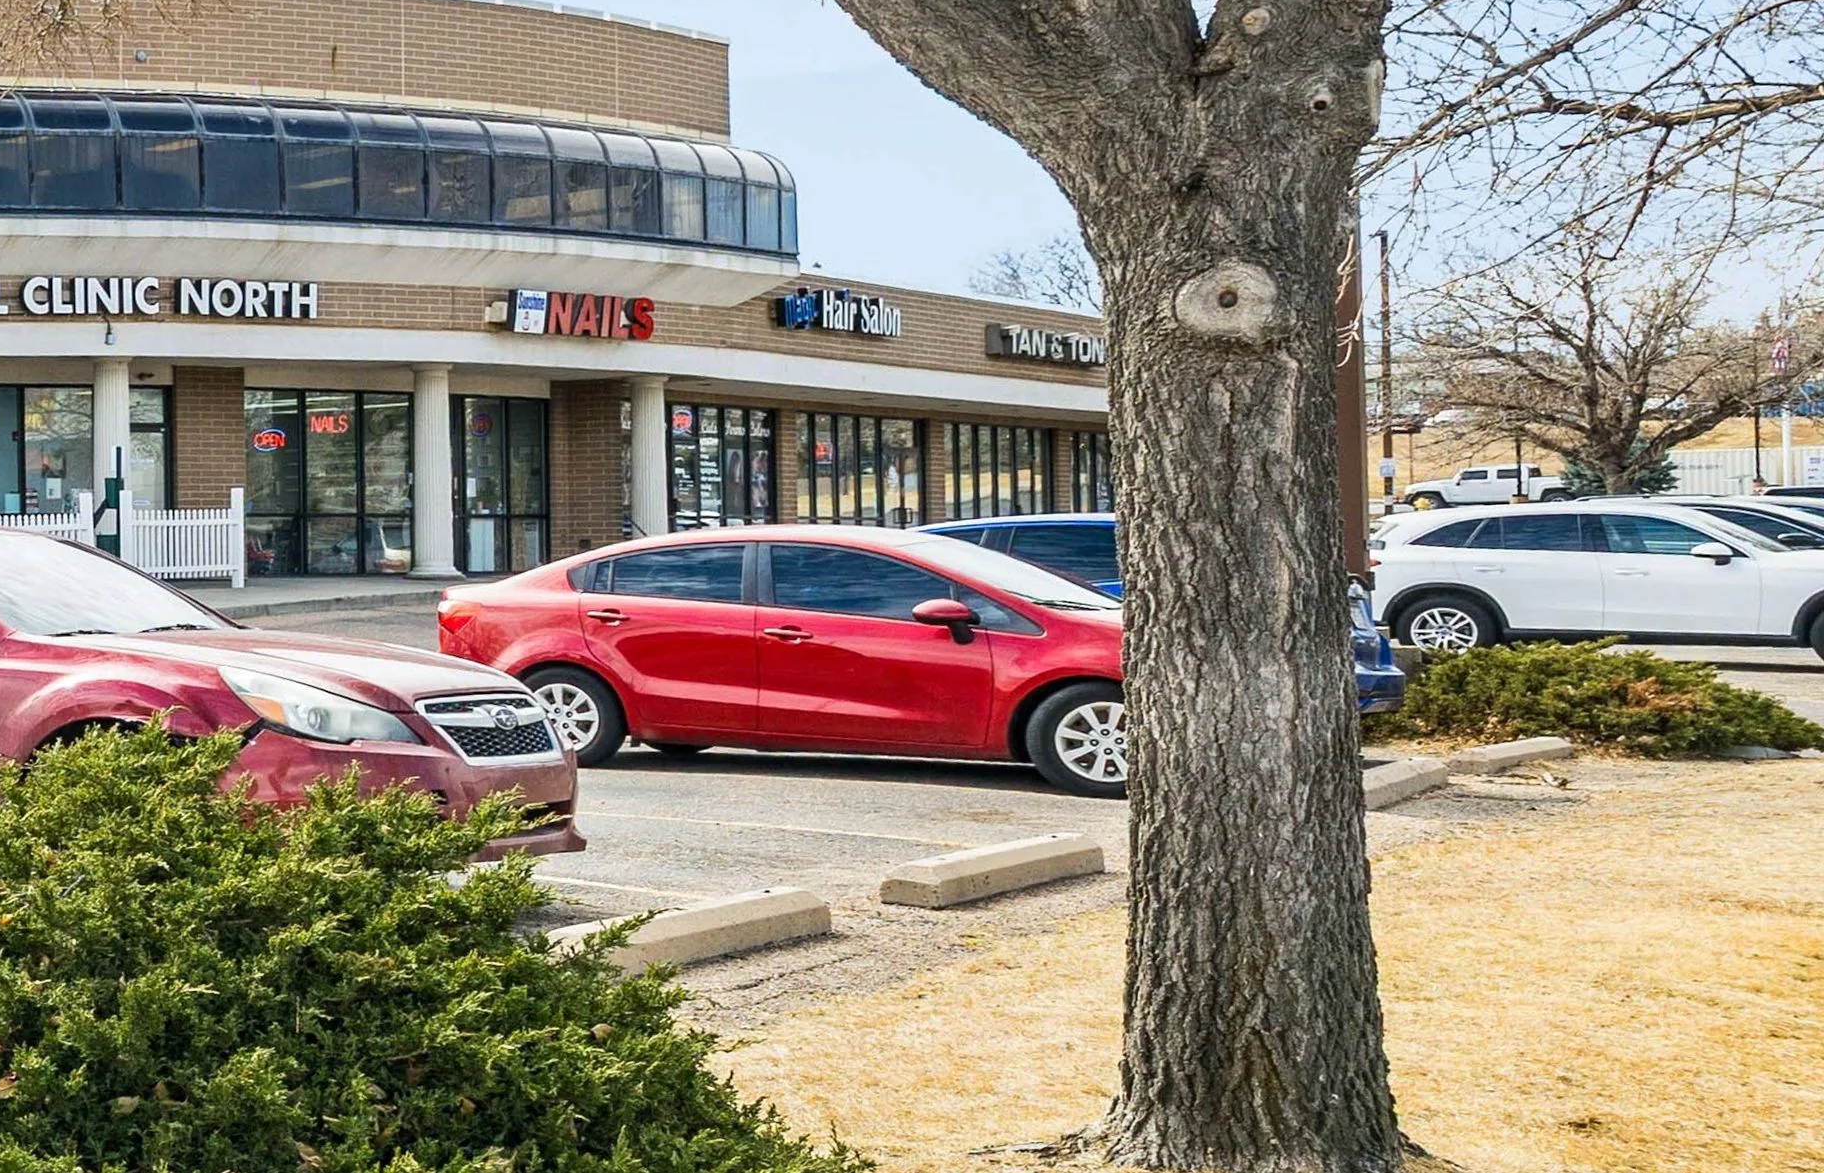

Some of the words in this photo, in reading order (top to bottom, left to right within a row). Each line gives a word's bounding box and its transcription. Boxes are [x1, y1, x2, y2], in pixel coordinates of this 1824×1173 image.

[23, 275, 160, 316] CLINIC
[179, 278, 318, 319] NORTH
[822, 289, 857, 331] Hair
[861, 295, 901, 337] Salon
[548, 291, 655, 341] NAILS
[1008, 327, 1047, 357] TAN
[254, 432, 286, 448] OPEN
[310, 413, 349, 434] NAILS
